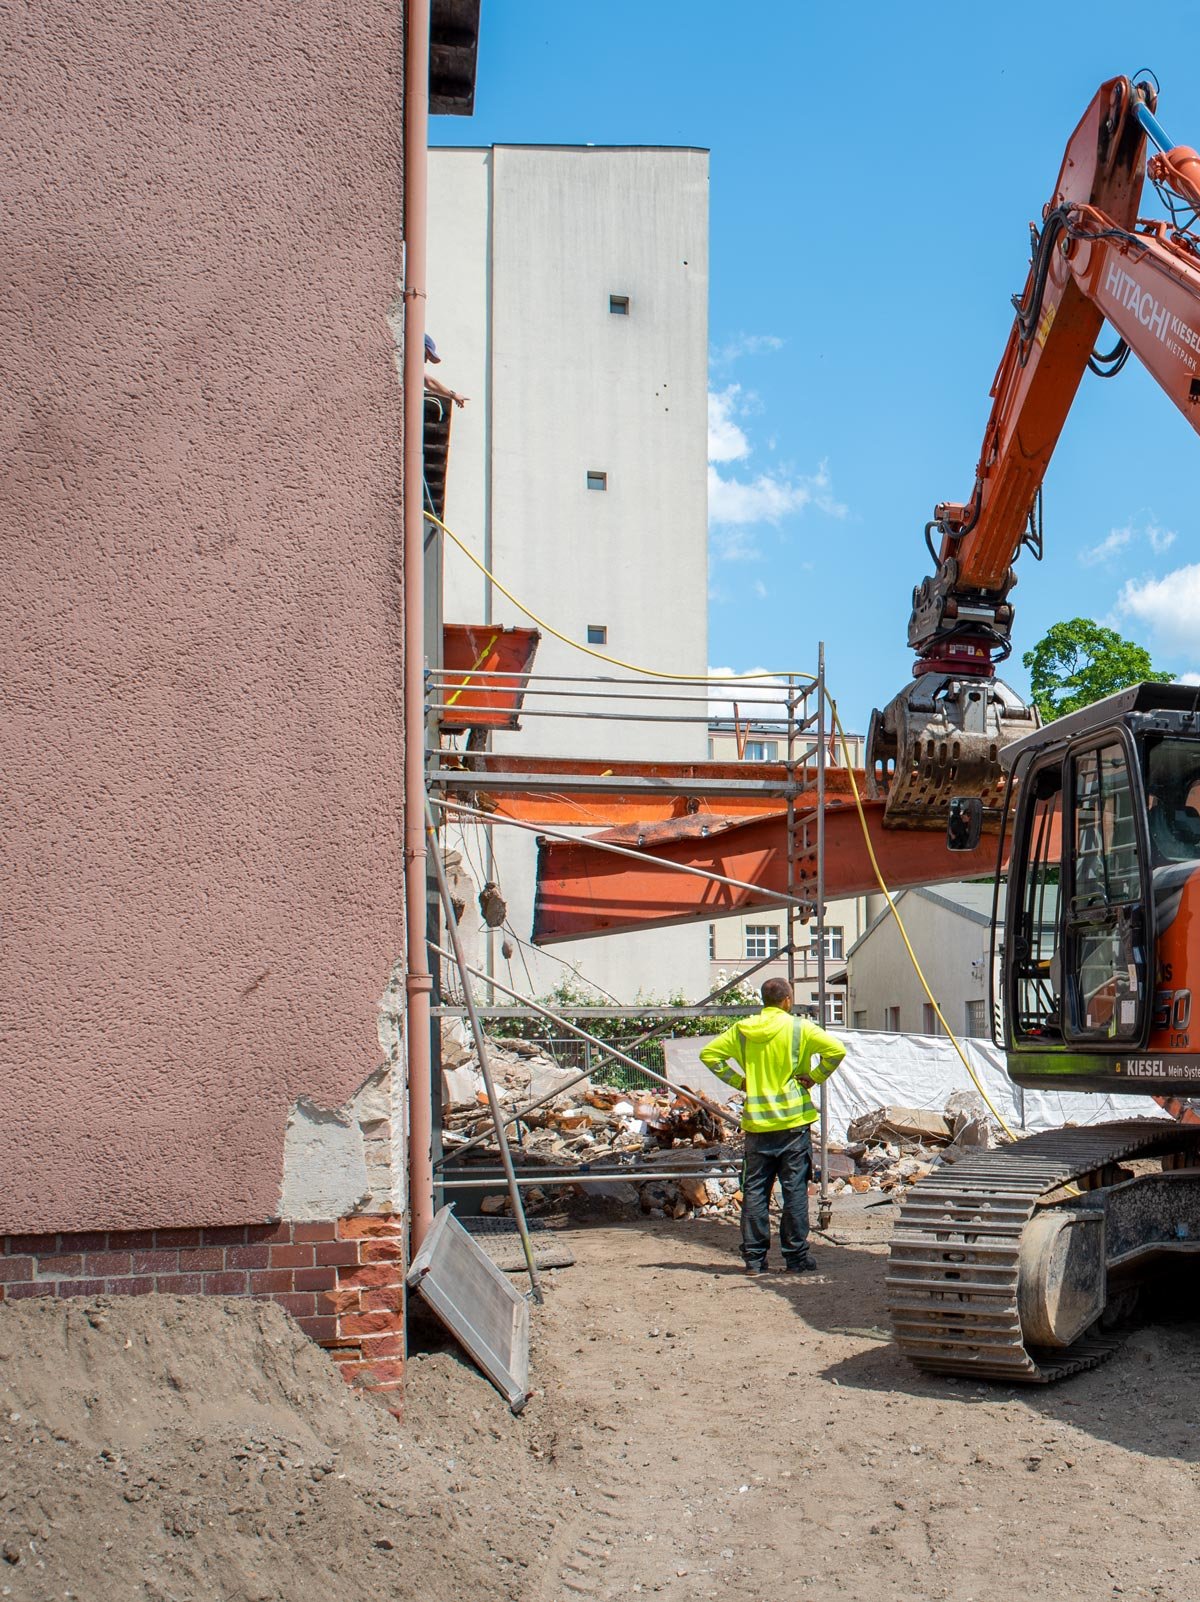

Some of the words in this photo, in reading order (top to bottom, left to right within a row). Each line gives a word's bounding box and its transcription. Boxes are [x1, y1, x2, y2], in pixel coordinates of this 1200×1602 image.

[1105, 262, 1171, 342] HITACHI
[1166, 338, 1198, 372] MIETPARK
[1127, 1060, 1167, 1077] KIESEL
[1168, 1065, 1183, 1077] Mein
